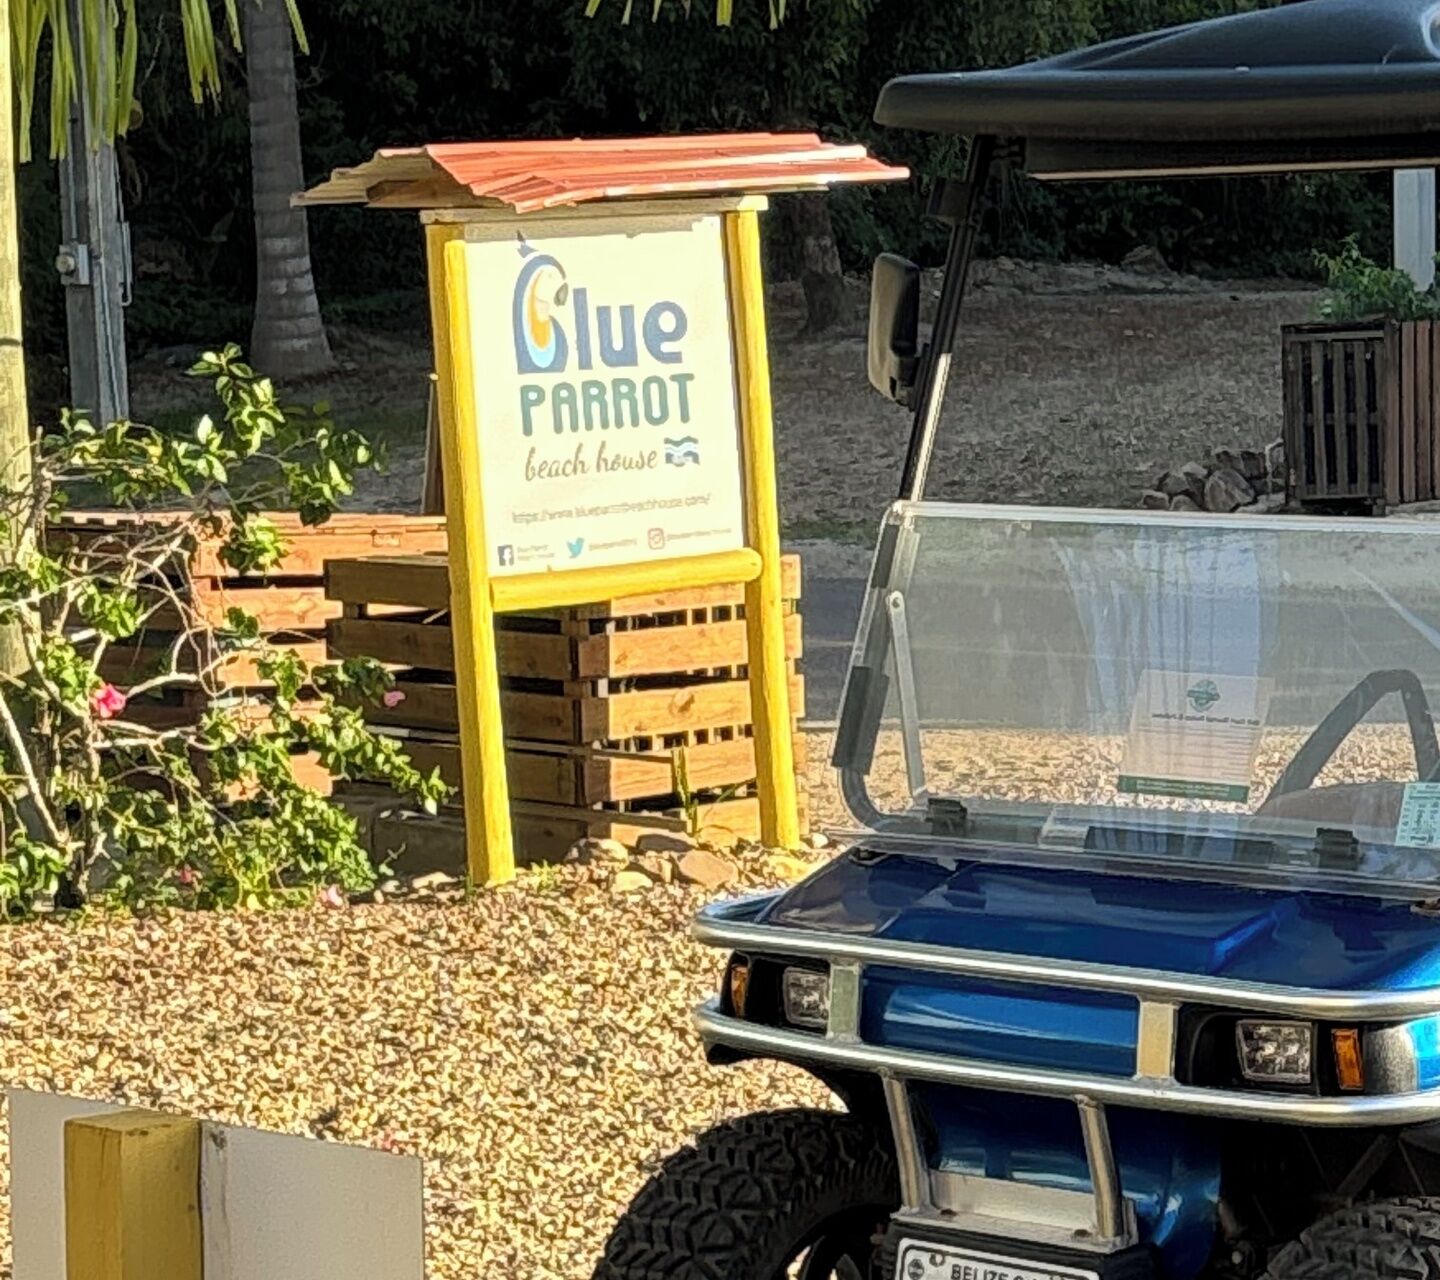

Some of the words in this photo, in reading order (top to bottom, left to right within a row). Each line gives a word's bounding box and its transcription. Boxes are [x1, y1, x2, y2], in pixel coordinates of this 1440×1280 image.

[512, 251, 688, 375] Blue
[520, 372, 695, 437] PARROT
[524, 442, 590, 482] beach
[596, 440, 658, 473] house
